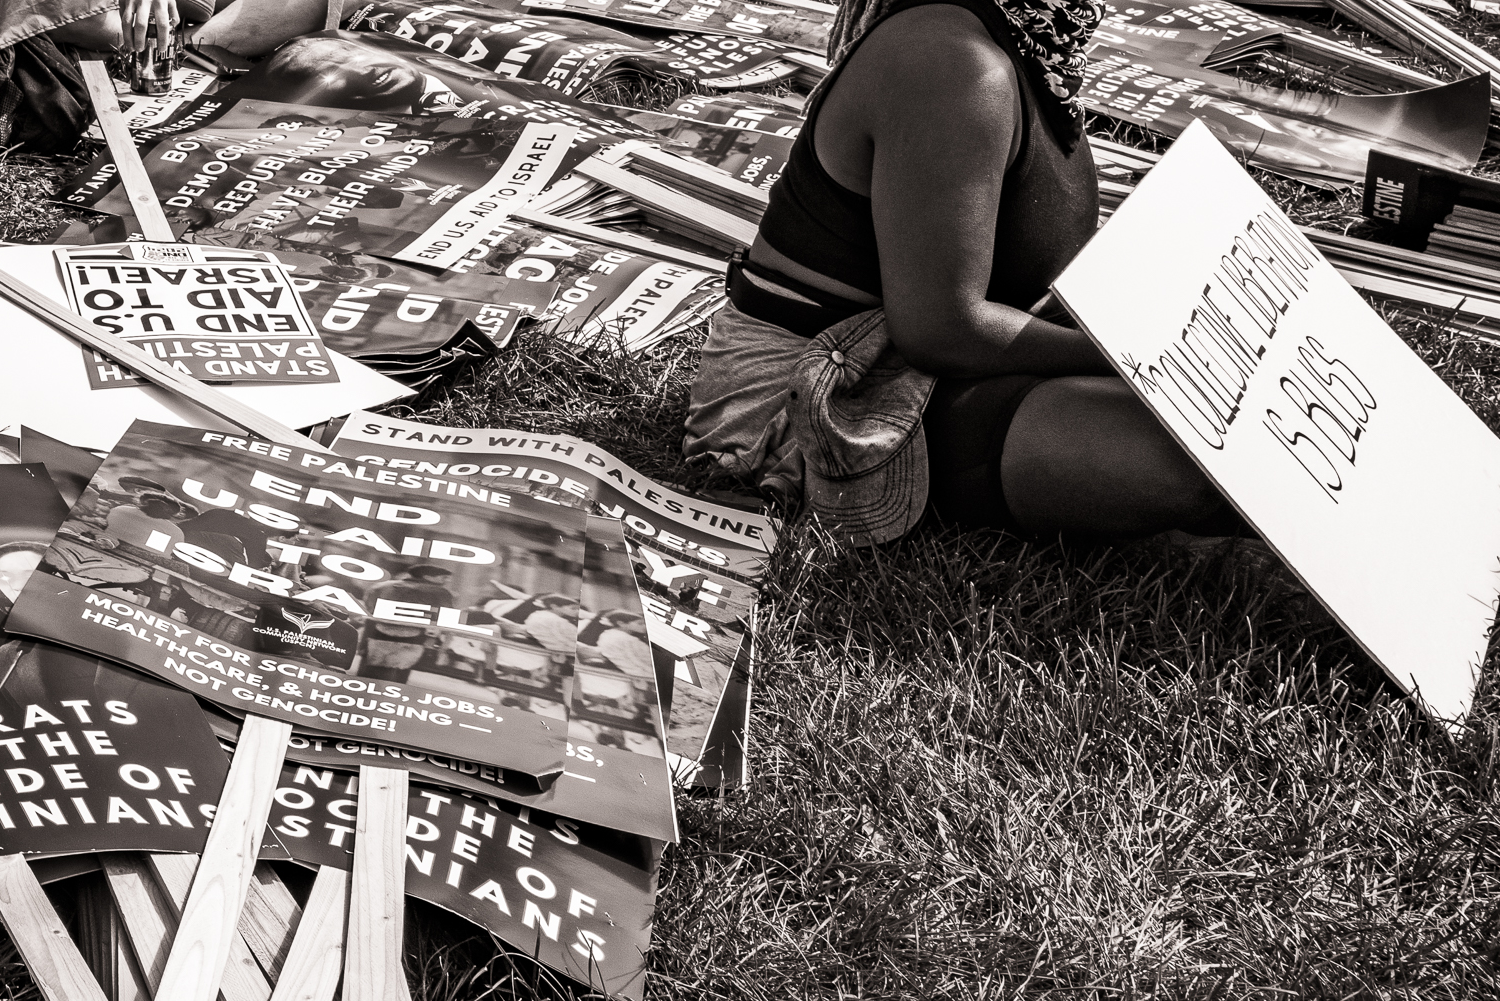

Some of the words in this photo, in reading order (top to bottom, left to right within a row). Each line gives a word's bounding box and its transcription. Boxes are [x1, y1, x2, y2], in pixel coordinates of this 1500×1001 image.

[66, 162, 118, 203] STAND
[165, 130, 288, 209] DEMOCRATS
[275, 120, 303, 131] &
[213, 126, 345, 214] REPUBLICANS
[249, 185, 302, 231] HAVE
[301, 149, 370, 186] BLOOD
[359, 121, 399, 150] ON
[307, 181, 374, 227] THEIR
[368, 139, 435, 182] HANDS!
[416, 239, 445, 261] END
[445, 218, 479, 240] U.S.
[475, 197, 498, 219] AID
[492, 187, 517, 202] TO
[506, 133, 557, 188] ISRAEL
[75, 265, 280, 285] ISRAEL!
[83, 288, 164, 310] TO
[186, 287, 284, 309] AID
[92, 312, 176, 334] U.S
[196, 313, 300, 333] END
[205, 359, 330, 377] STAND
[1279, 335, 1378, 467] BLISS
[201, 431, 291, 461] FREE
[300, 452, 512, 508] PALESTINE
[361, 423, 474, 446] STAND
[487, 436, 574, 457] WITH
[585, 452, 765, 540] PALESTINE
[1262, 408, 1343, 504] IS
[181, 479, 309, 536] U.S.
[323, 527, 497, 566] AID
[248, 470, 442, 526] END
[598, 502, 731, 567] JOE'S
[144, 529, 496, 636] ISRAEL
[266, 539, 386, 581] TO
[80, 608, 271, 692] HEALTHCARE,
[278, 680, 303, 698] &
[303, 683, 454, 727] HOUSING
[84, 593, 190, 639] MONEY
[194, 634, 255, 666] FOR
[258, 658, 409, 703] SCHOOLS,
[416, 693, 504, 723] JOBS,
[163, 656, 227, 691] NOT
[231, 687, 397, 732] GENOCIDE!
[117, 762, 197, 795] OF
